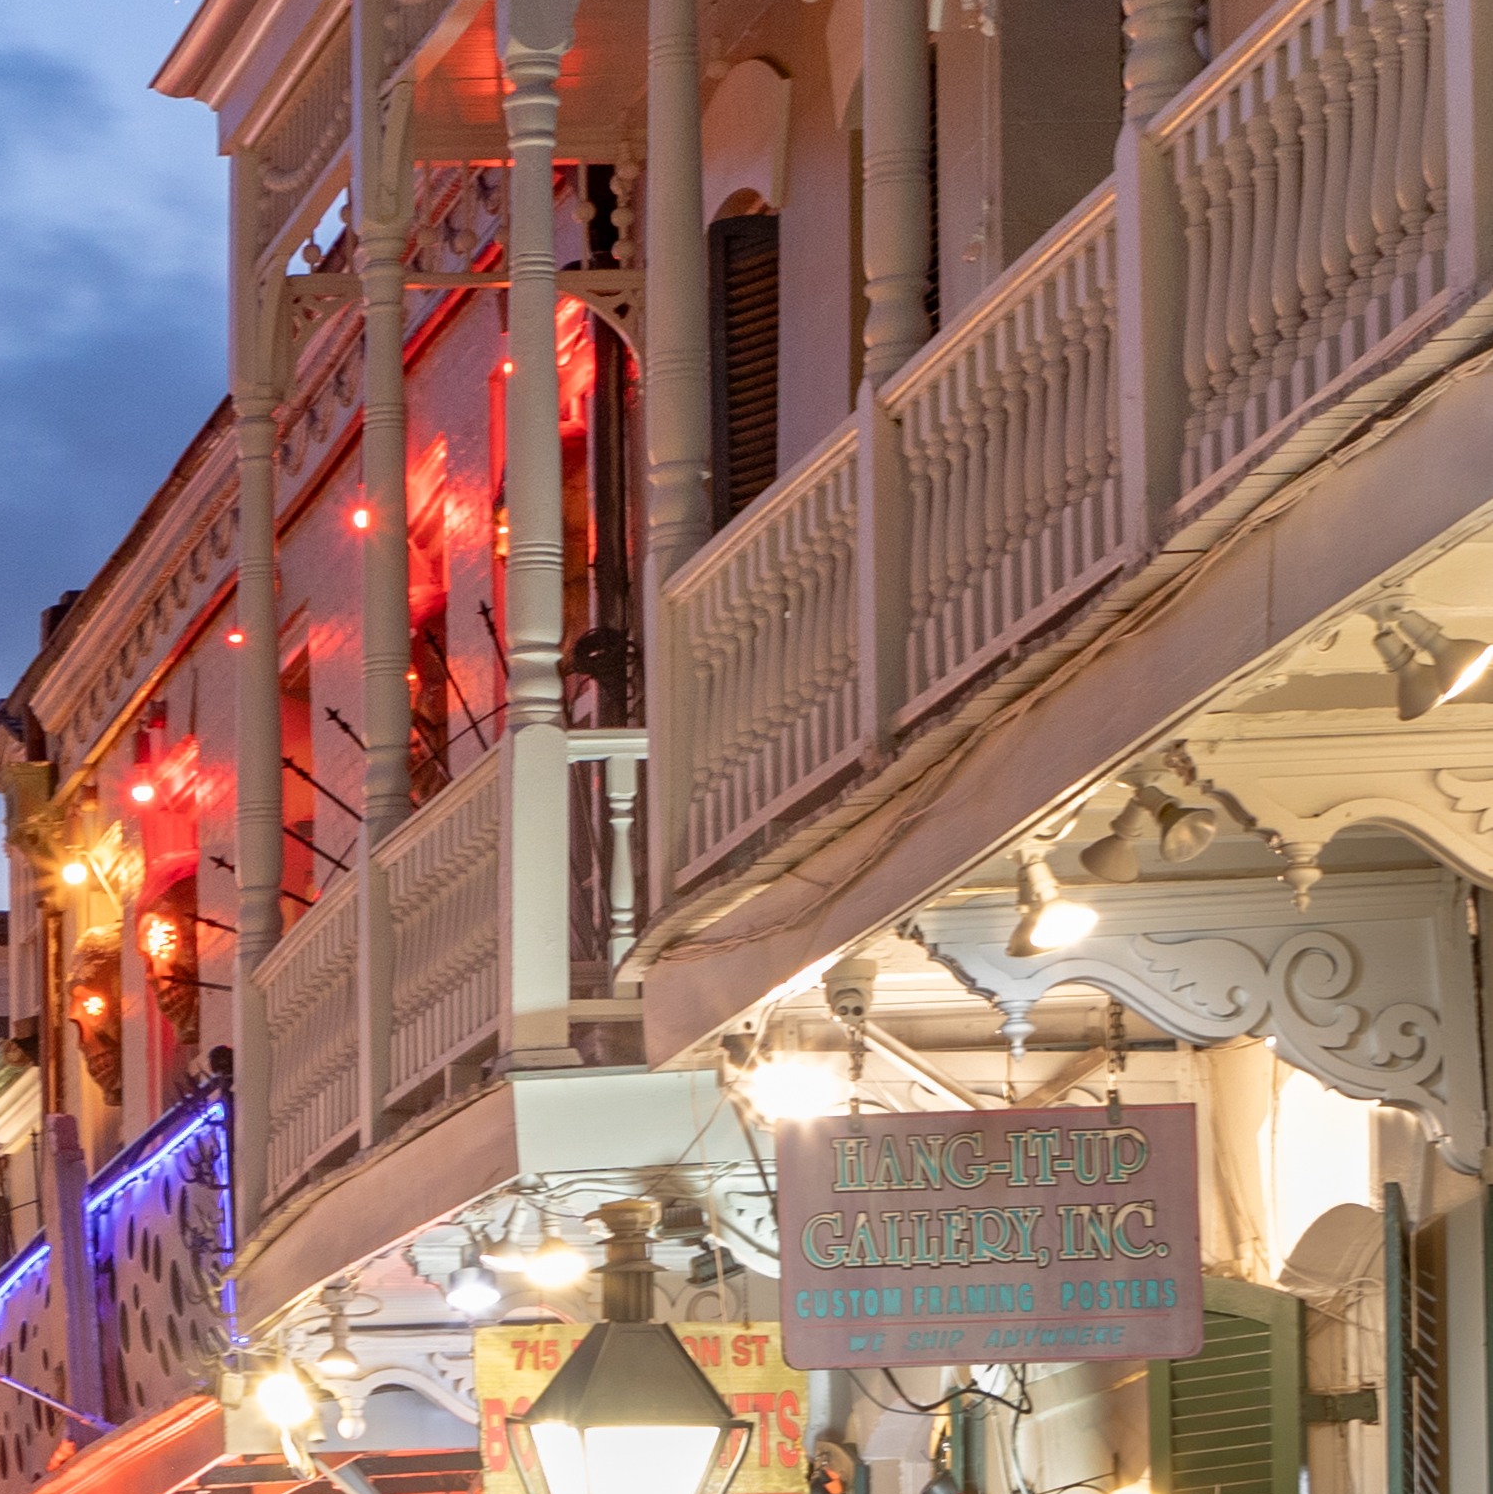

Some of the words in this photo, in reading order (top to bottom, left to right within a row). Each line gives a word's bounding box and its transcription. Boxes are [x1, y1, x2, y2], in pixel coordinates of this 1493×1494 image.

[831, 1125, 1150, 1193] HANG-IT-UP
[801, 1206, 1051, 1269] GALLERY,
[1057, 1199, 1170, 1260] INC.
[796, 1286, 903, 1319] CUSTOM
[913, 1283, 1034, 1316] FRAMING
[1061, 1278, 1177, 1310] POSTERS
[510, 1339, 561, 1371] 715
[732, 1335, 771, 1366] ST
[848, 1332, 885, 1352] WE
[903, 1329, 965, 1351] SHIP
[982, 1325, 1125, 1349] ANYWHERE
